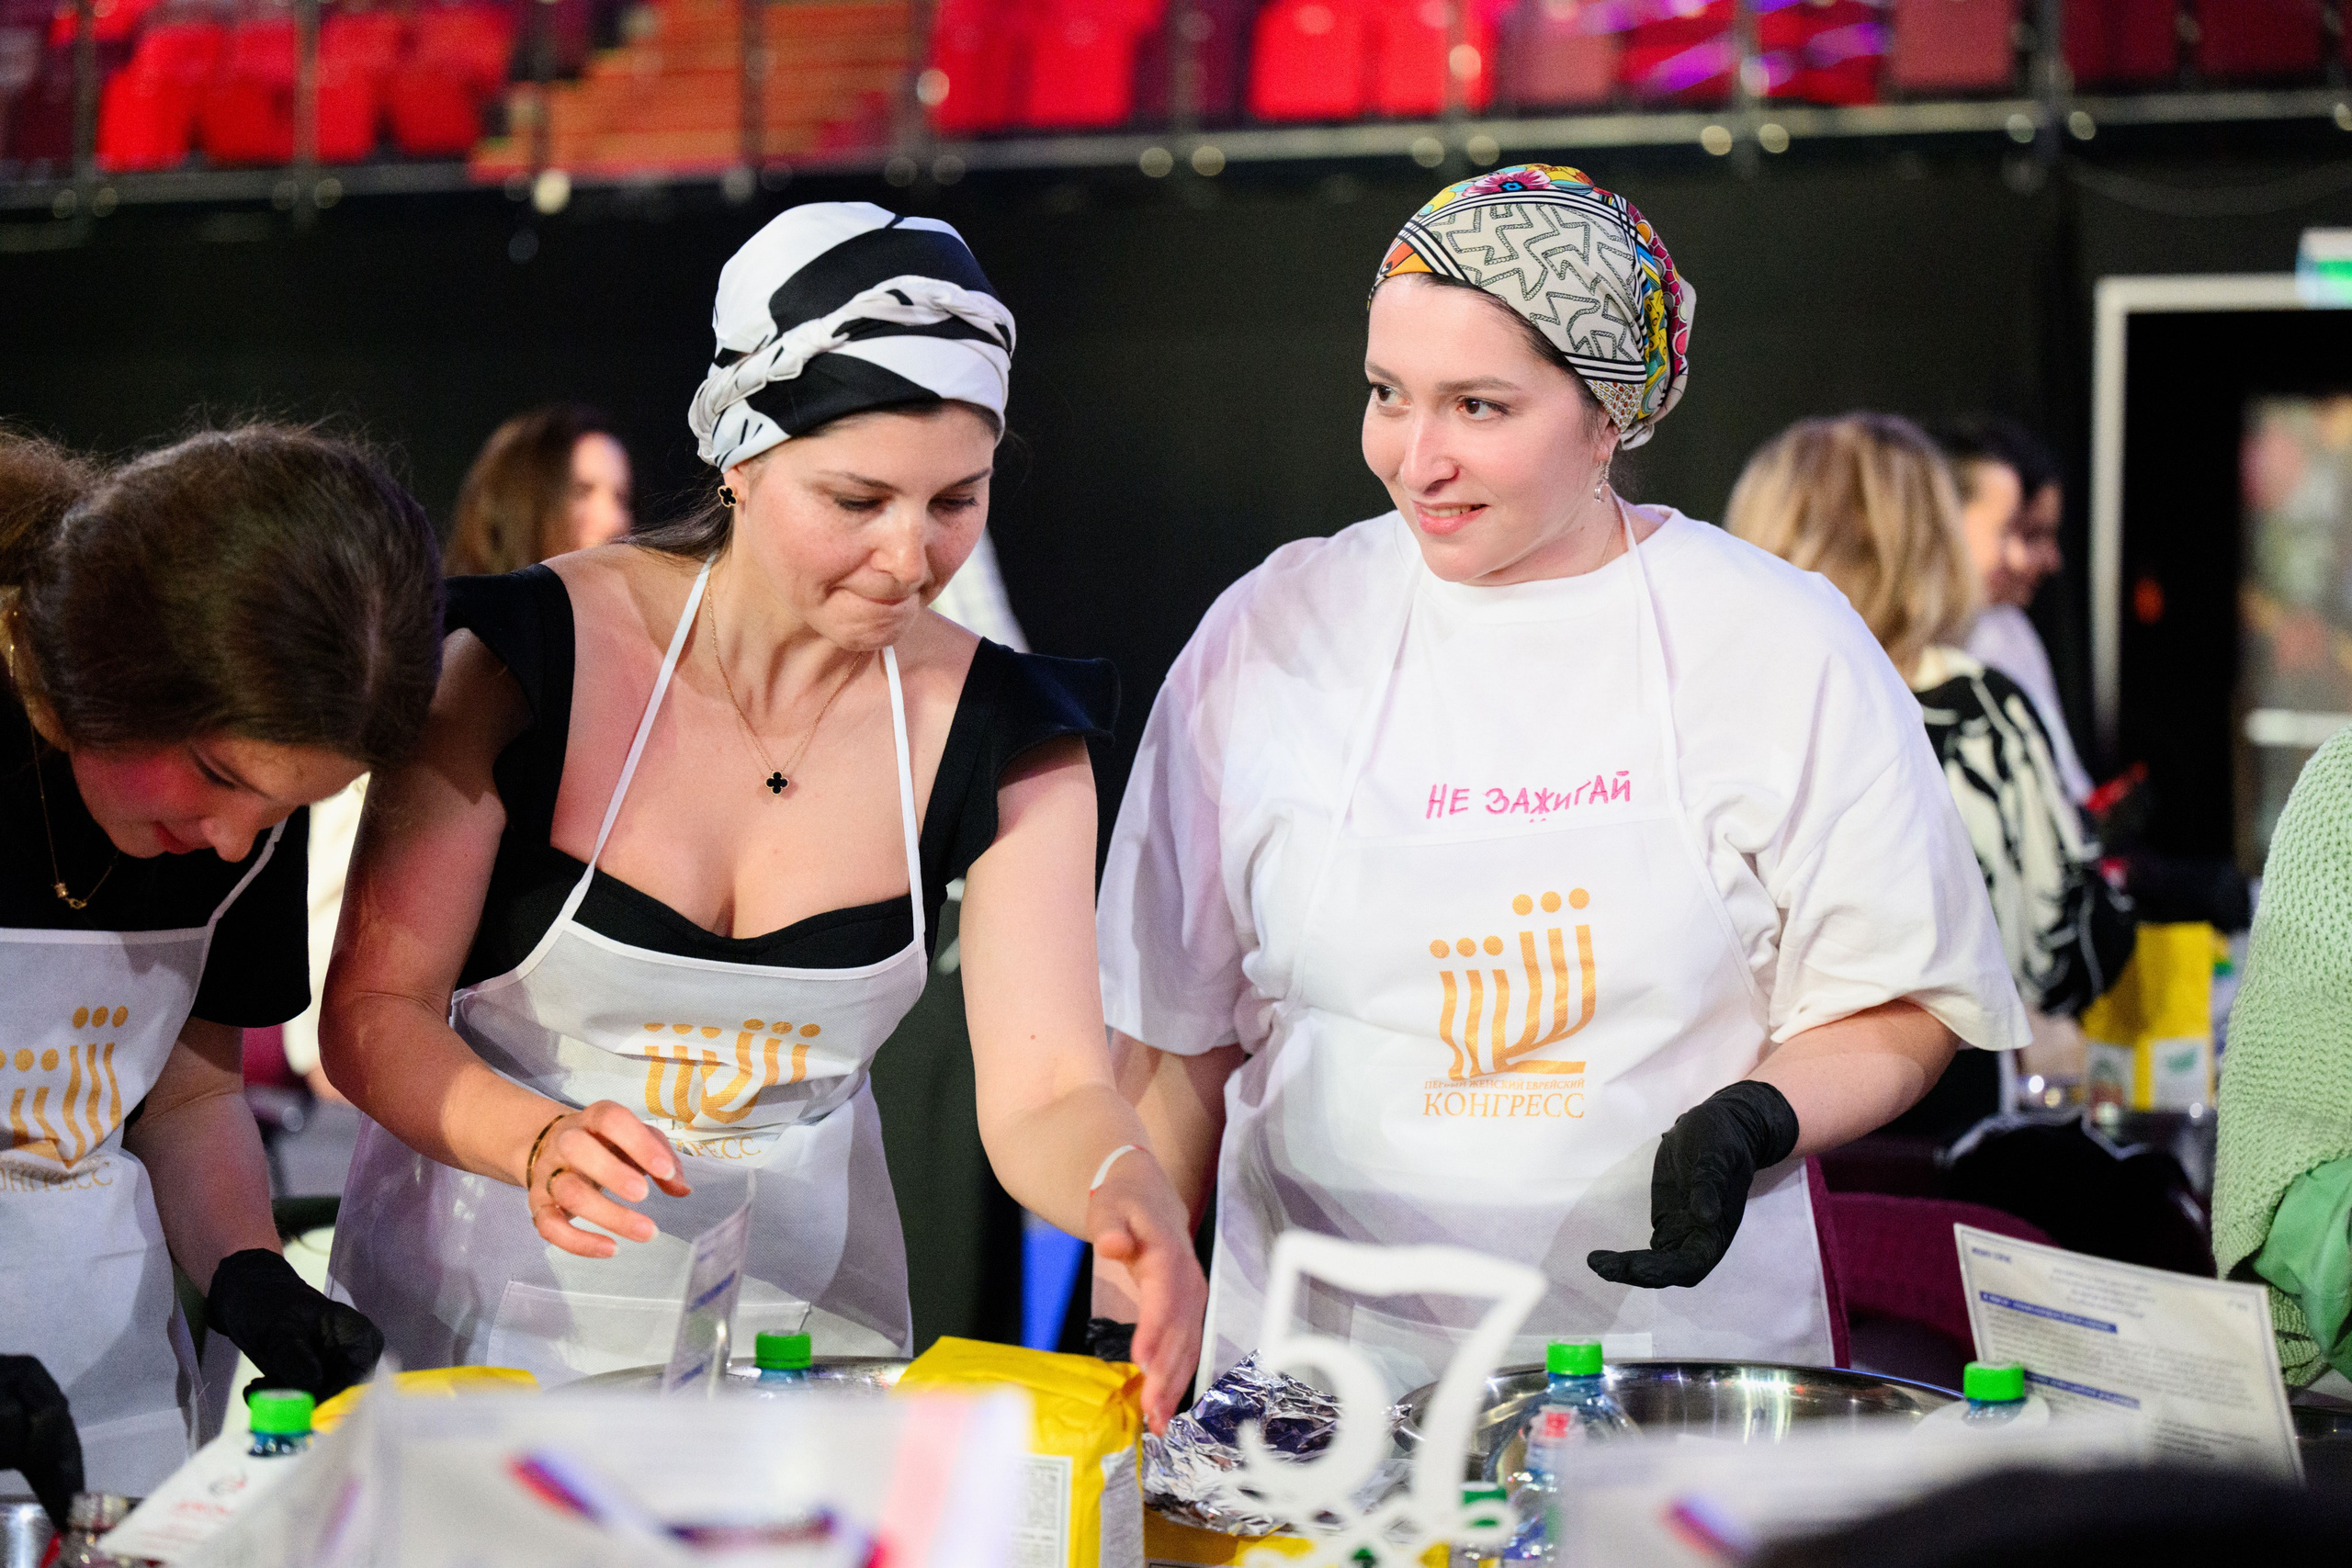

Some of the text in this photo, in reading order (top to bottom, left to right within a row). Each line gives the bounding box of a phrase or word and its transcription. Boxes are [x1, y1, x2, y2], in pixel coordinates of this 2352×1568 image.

[1425, 784, 1470, 819] НЕ
[1470, 1078, 1524, 1090] ЖЕНСКИЙ
[1525, 1077, 1586, 1090] ЕВРЕЙСКИЙ
[1422, 1091, 1585, 1119] КОНГРЕСС
[1238, 1227, 1549, 1523] 57
